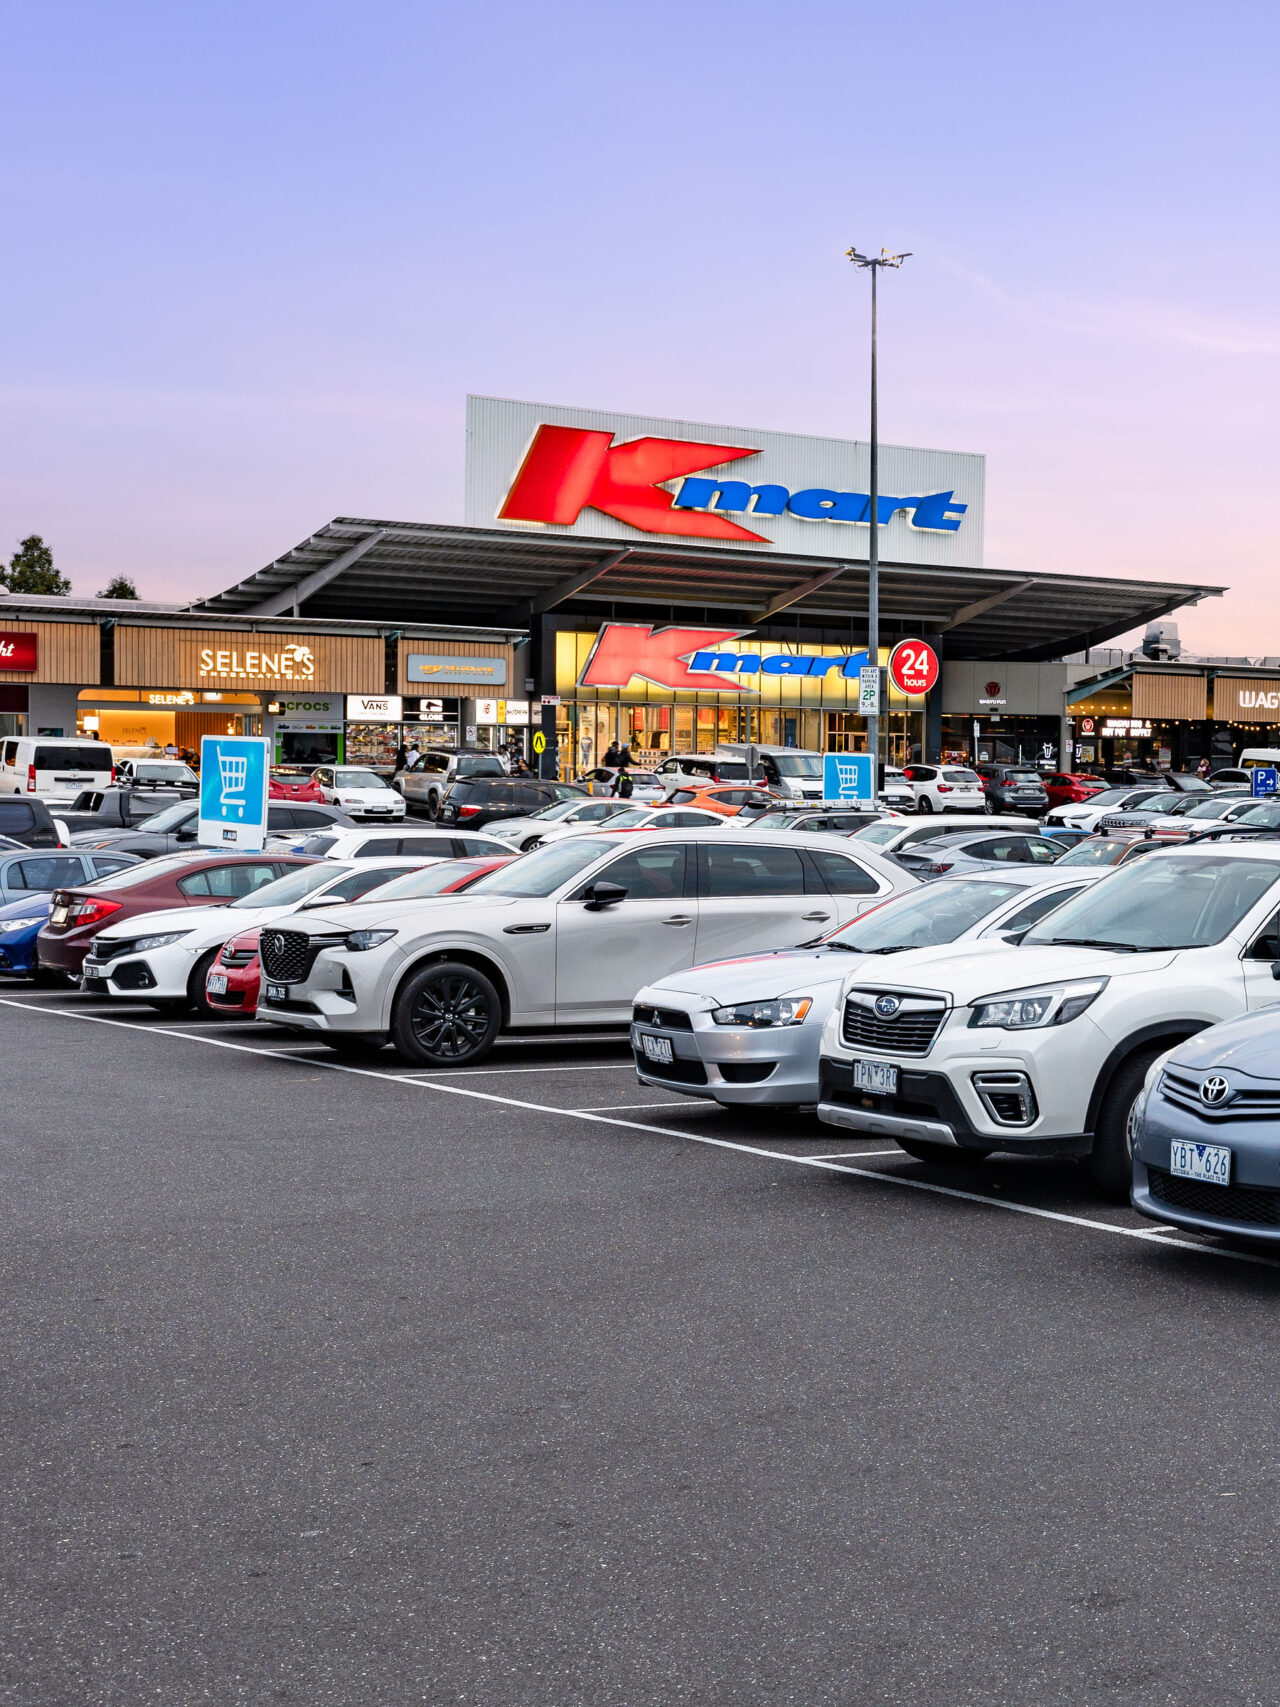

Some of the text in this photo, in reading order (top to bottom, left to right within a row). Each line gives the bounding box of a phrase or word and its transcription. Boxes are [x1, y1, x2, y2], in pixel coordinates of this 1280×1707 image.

[497, 423, 969, 544] Kmart
[200, 645, 315, 675] SELENE'S
[575, 621, 871, 694] Kmart
[901, 648, 929, 676] 24
[200, 670, 314, 681] CHOCOLATE CAFE
[903, 676, 927, 688] hours
[862, 689, 876, 701] 2P
[286, 702, 330, 712] crocs
[361, 700, 389, 711] VANS
[419, 713, 444, 721] GLOBE
[1106, 719, 1130, 728] WAGYU
[1101, 728, 1114, 737] HOT
[1130, 728, 1152, 737] BUFFET
[1257, 771, 1266, 784] P
[855, 1064, 873, 1085] 1PN
[1172, 1145, 1227, 1177] YBT 626
[1202, 1173, 1215, 1181] PLACE
